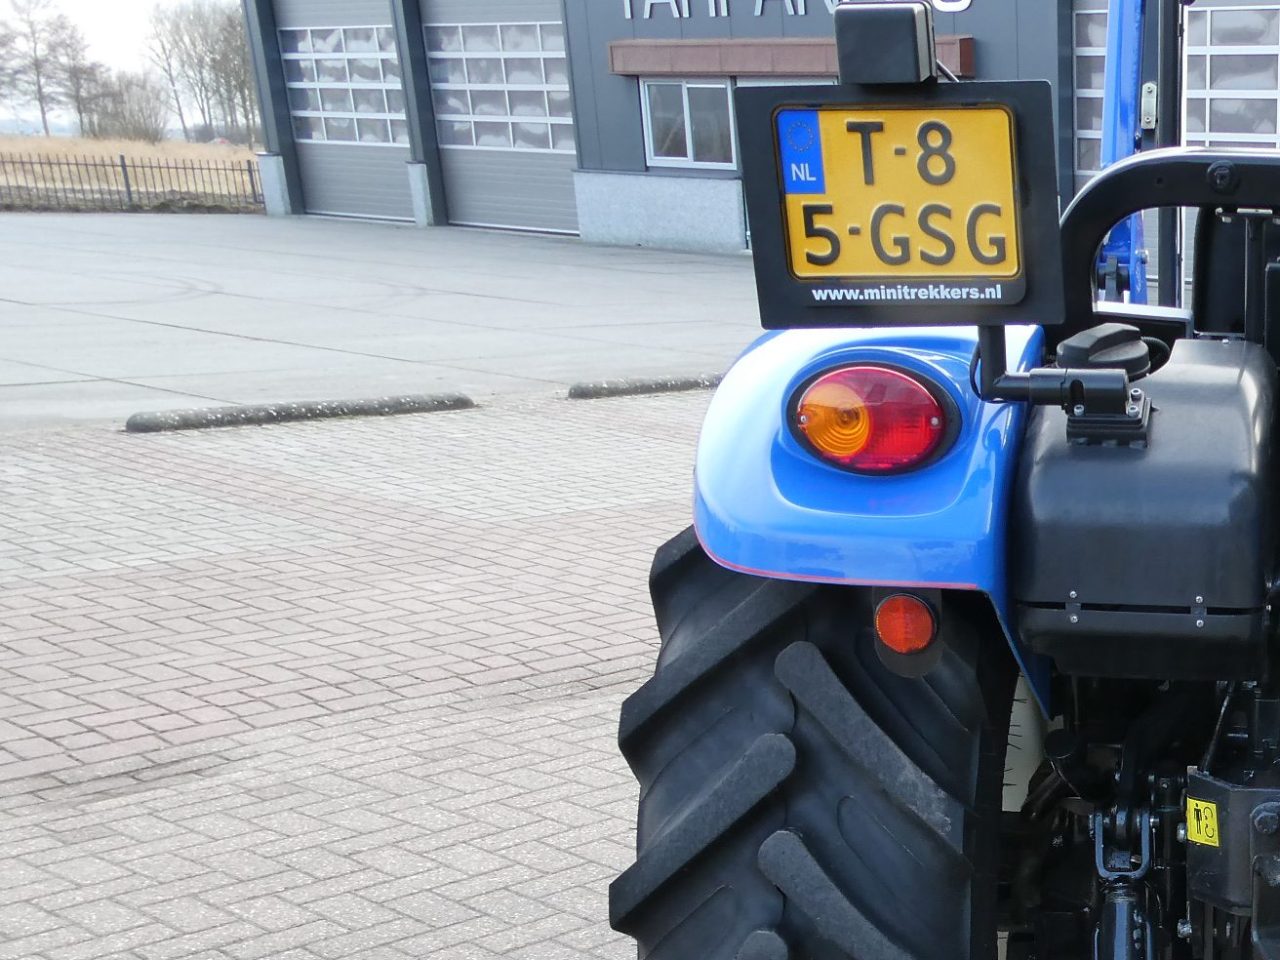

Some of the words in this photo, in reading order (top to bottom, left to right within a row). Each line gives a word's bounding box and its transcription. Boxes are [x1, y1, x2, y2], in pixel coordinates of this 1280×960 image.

[791, 163, 816, 181] NL
[846, 120, 956, 186] T-8
[802, 203, 1007, 266] 5-GSG
[811, 285, 1002, 300] www.minitrekkers.nl
